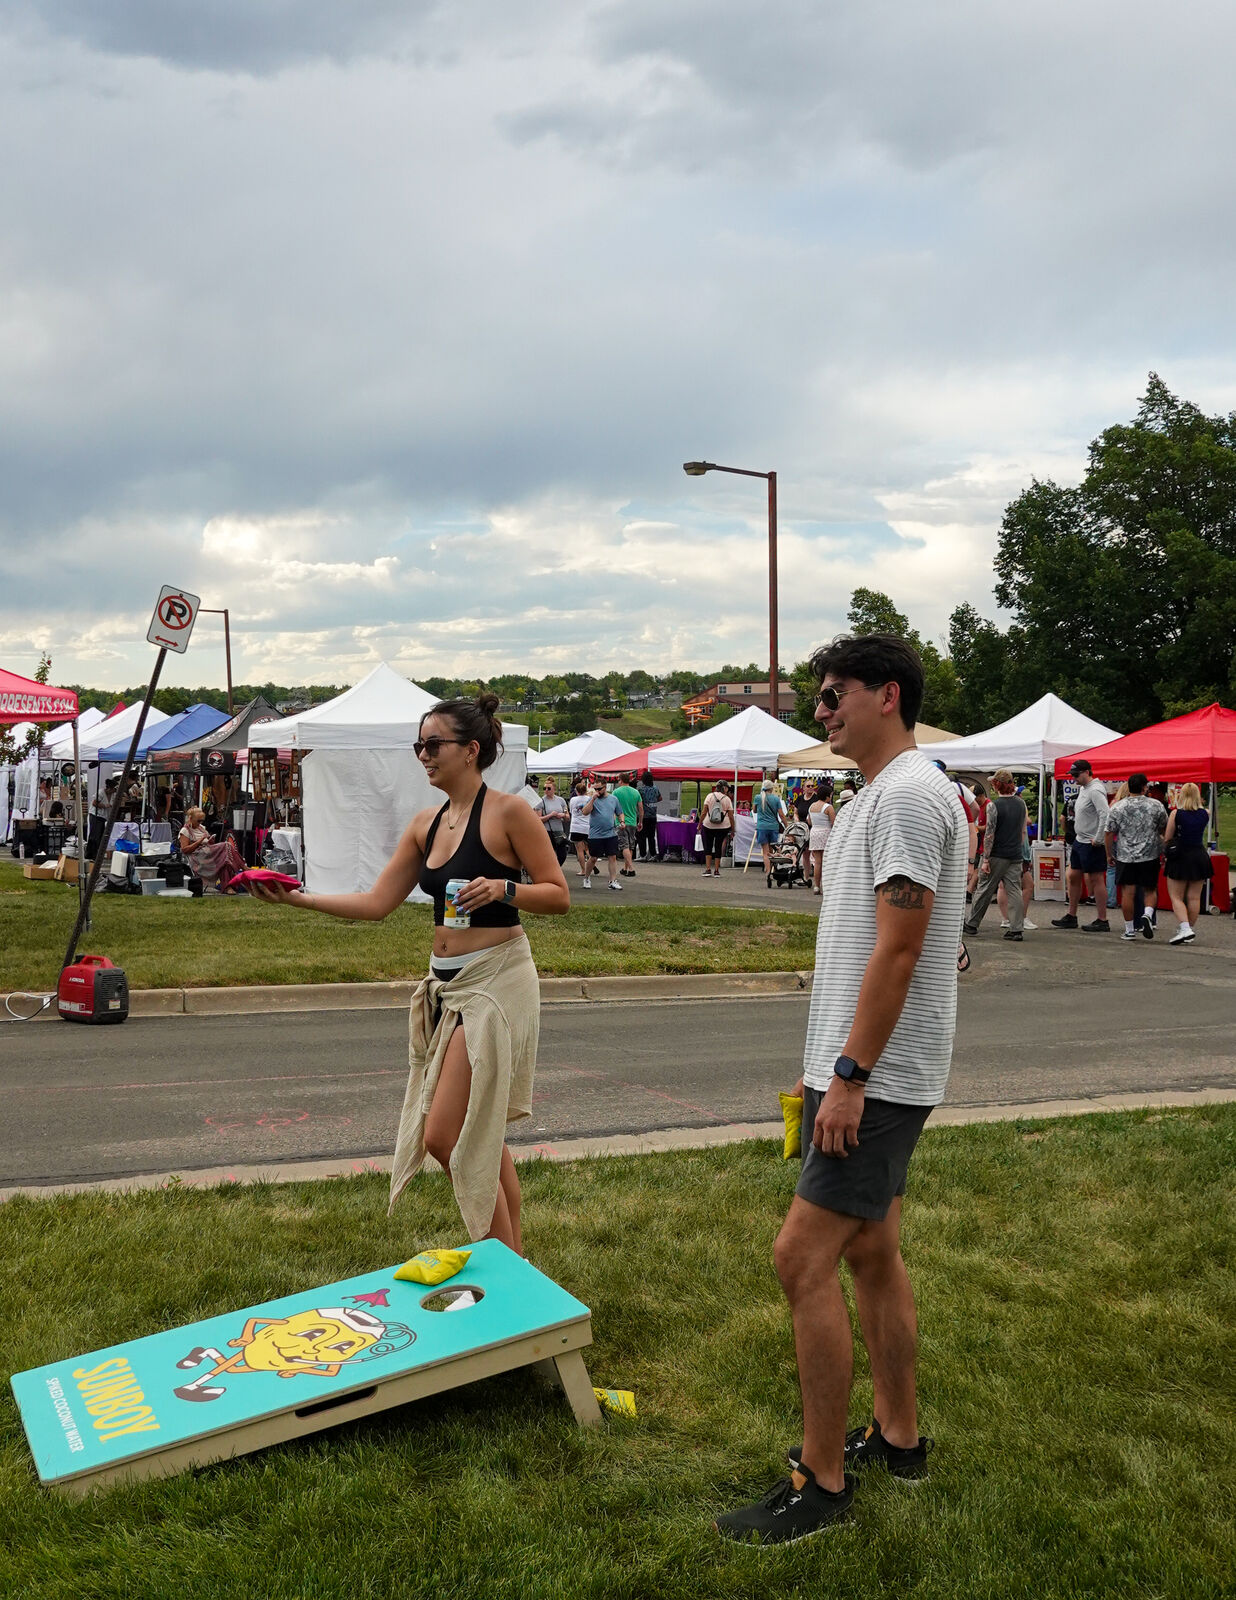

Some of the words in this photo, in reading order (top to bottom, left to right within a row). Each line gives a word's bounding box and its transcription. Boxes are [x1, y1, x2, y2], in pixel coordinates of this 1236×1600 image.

[46, 1377, 64, 1399] SPIKED
[72, 1358, 160, 1443] SUNBOY
[53, 1397, 77, 1430] COCONUT
[65, 1428, 84, 1453] WATER
